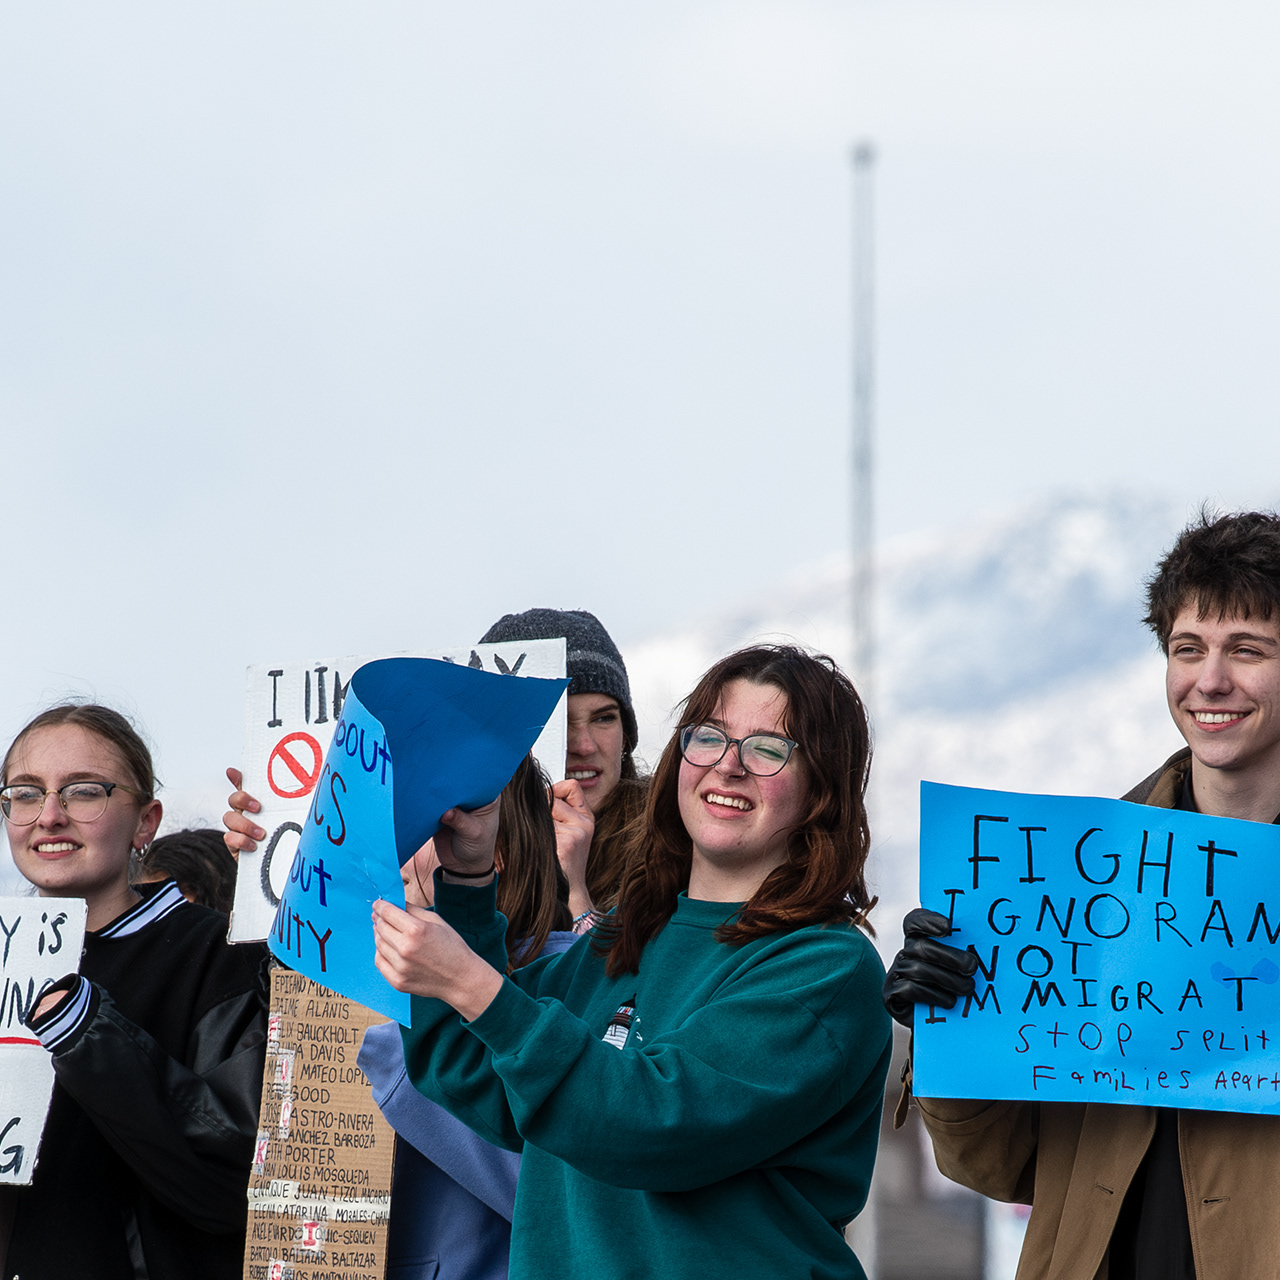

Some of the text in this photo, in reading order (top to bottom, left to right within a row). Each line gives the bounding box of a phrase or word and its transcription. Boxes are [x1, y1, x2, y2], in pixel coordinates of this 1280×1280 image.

[267, 669, 284, 728] I
[968, 814, 1238, 898] FIGHT
[966, 940, 1092, 982] NOT
[305, 999, 350, 1020] ALANIS
[297, 1022, 360, 1045] BAUCKHOLT
[311, 1043, 345, 1063] DAVIS
[300, 1064, 337, 1083] MATEO
[291, 1085, 330, 1104] GOOD
[285, 1145, 336, 1165] PORTER
[278, 1164, 310, 1180] LOUIS
[313, 1166, 369, 1186] MOSQUEDA
[294, 1183, 328, 1201] JUAN
[277, 1204, 327, 1221] CATARINA
[282, 1248, 328, 1265] BALTAZAR
[332, 1252, 376, 1268] BALTAZAR
